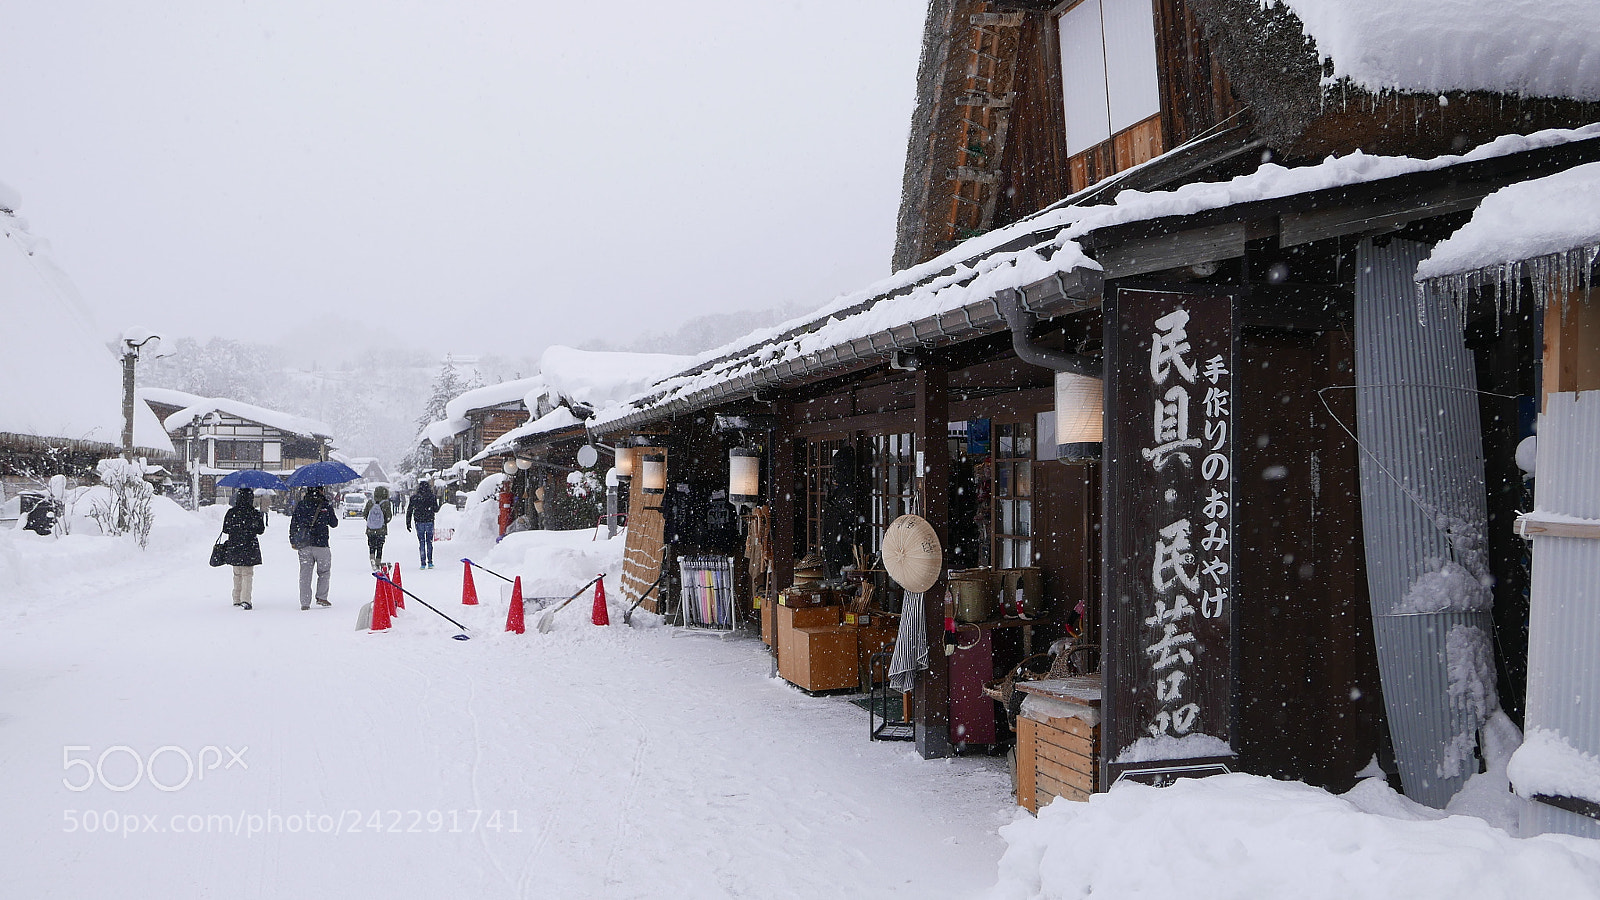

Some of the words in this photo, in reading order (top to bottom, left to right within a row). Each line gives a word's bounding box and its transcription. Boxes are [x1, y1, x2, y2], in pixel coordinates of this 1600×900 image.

[1201, 354, 1229, 619] 手作りのおみやげ
